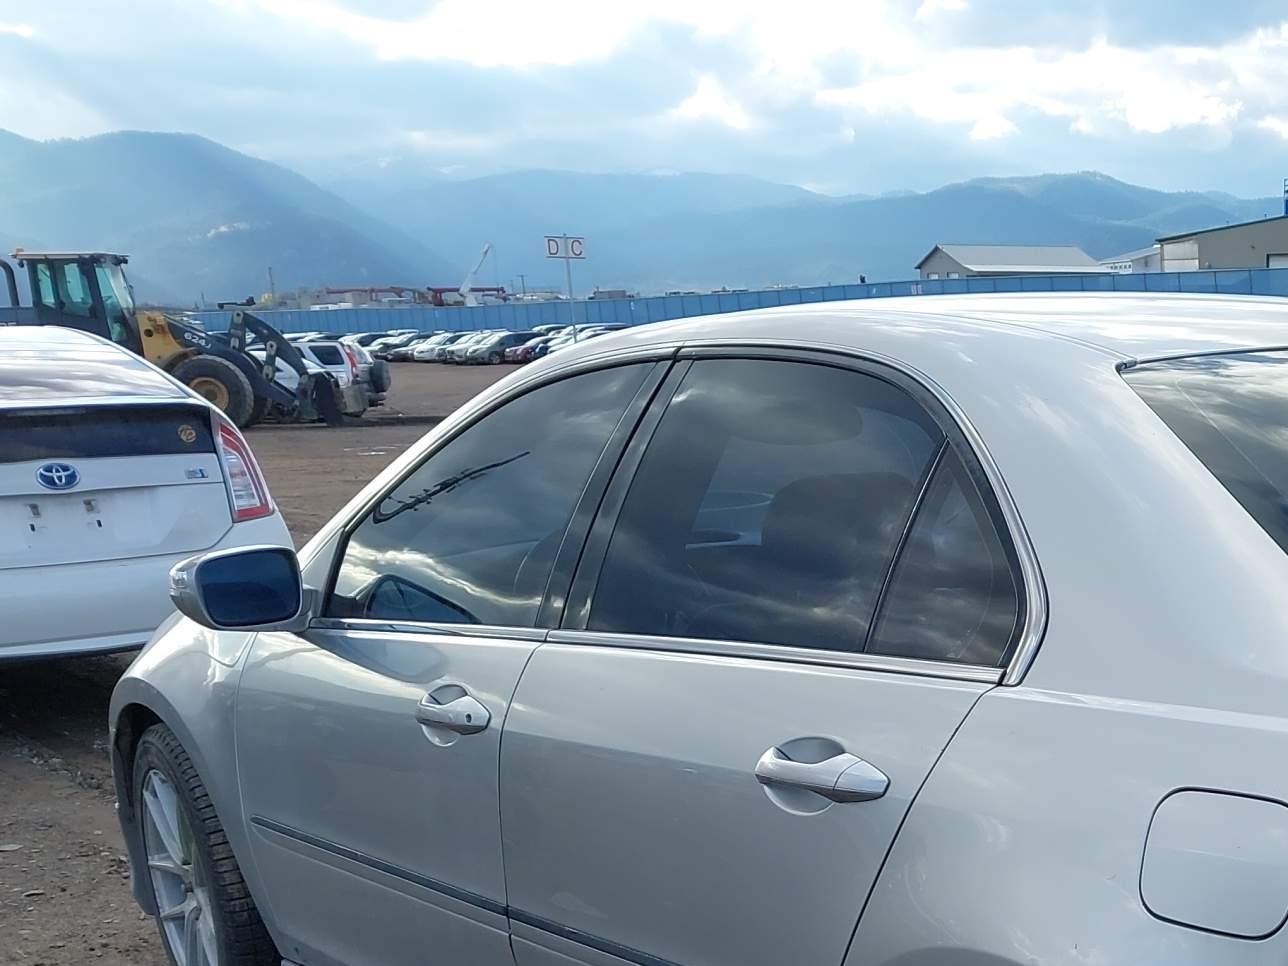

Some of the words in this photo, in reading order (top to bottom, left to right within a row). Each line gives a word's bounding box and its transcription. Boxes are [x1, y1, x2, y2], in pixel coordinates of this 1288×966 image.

[547, 238, 559, 256] D
[570, 239, 583, 257] C
[184, 331, 212, 350] 624J
